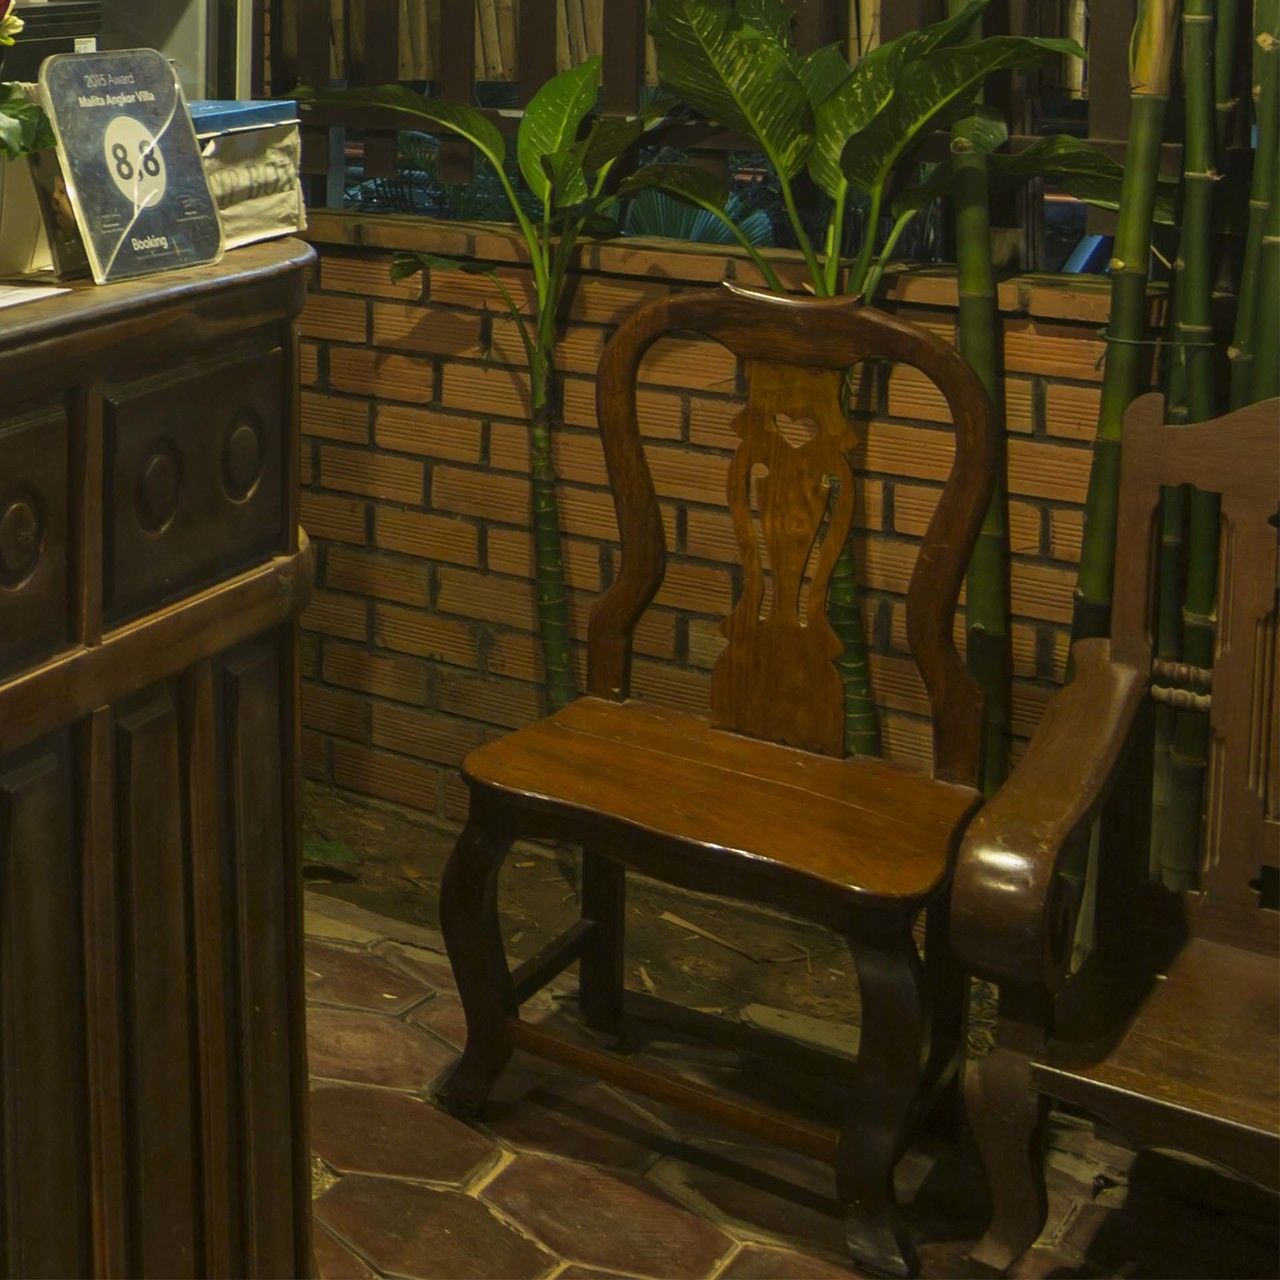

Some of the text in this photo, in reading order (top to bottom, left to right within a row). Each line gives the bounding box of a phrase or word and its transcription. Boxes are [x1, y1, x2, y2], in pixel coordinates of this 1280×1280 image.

[108, 73, 135, 86] Award
[106, 93, 134, 109] Angkor
[131, 234, 169, 252] Booking
